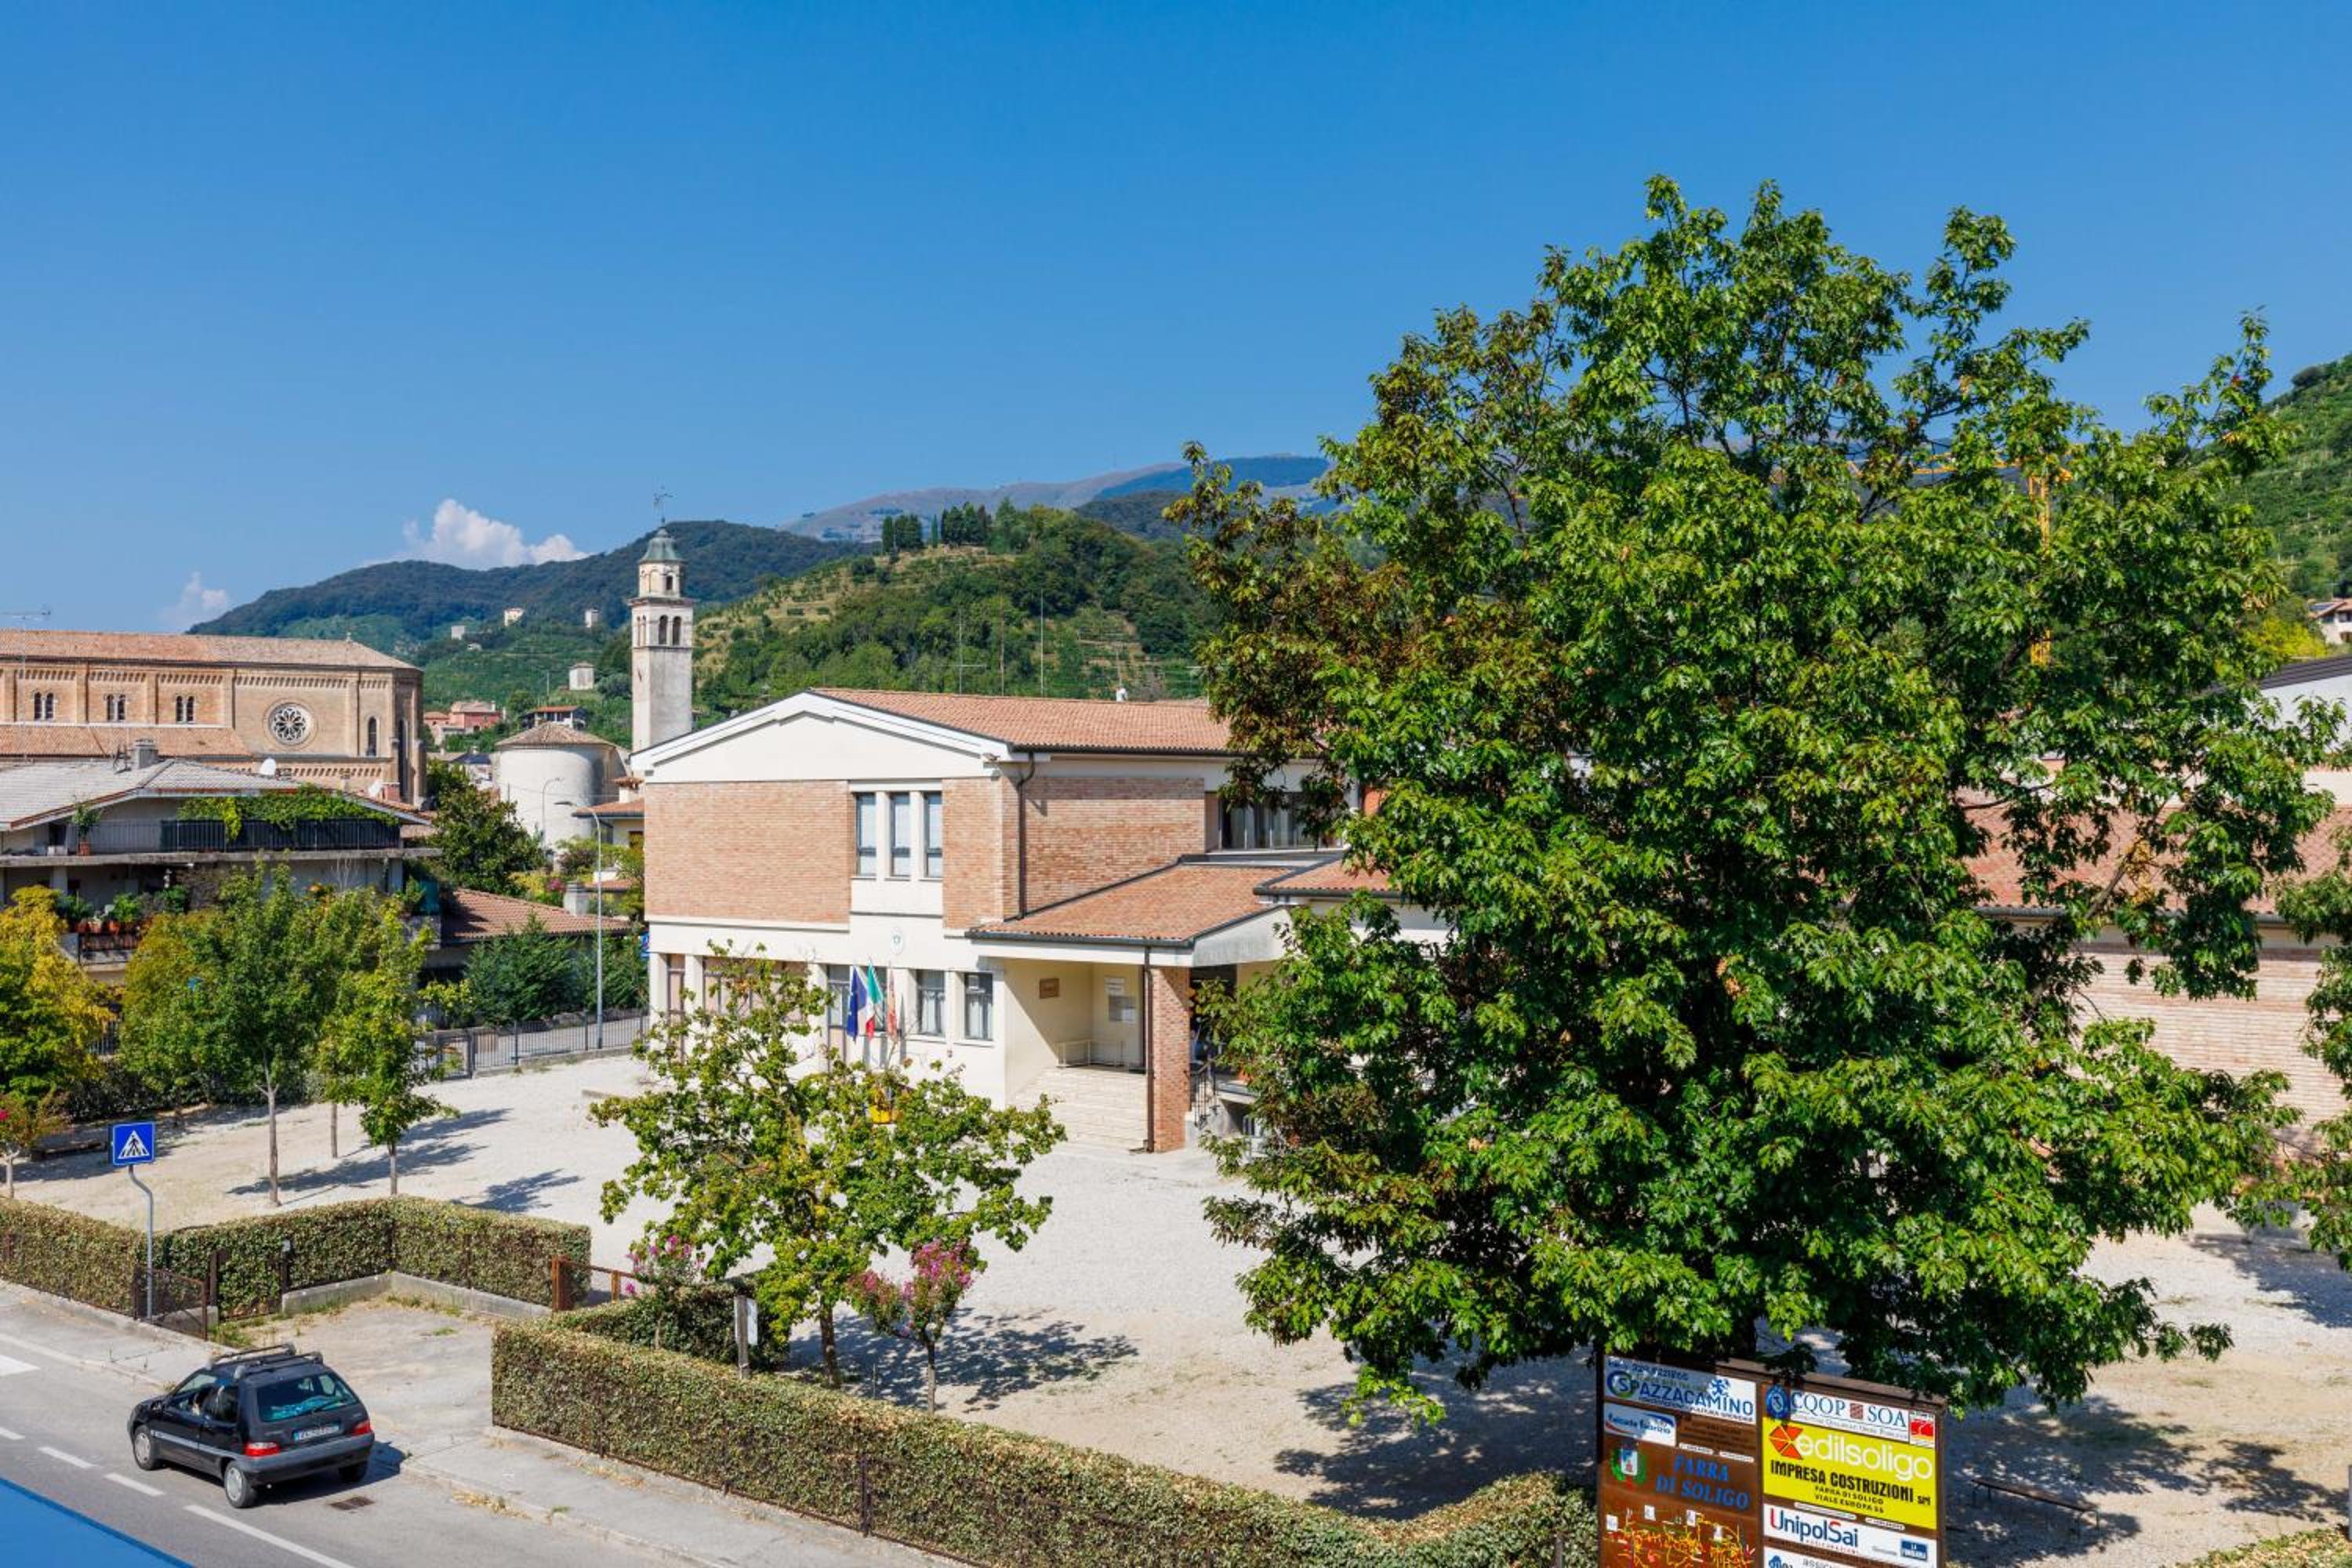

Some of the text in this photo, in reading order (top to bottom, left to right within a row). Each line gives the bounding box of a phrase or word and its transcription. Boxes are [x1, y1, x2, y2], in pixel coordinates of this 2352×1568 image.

[1791, 1391, 1846, 1417] CQOP
[1867, 1406, 1907, 1428] SOA
[1673, 1454, 1730, 1481] FARRA
[1795, 1433, 1933, 1481] edilsoligo
[1655, 1474, 1751, 1509] DI SOLIGO
[1771, 1460, 1826, 1484] IMPRESA
[1830, 1472, 1914, 1503] COSTRUZIONI
[1853, 1494, 1884, 1505] SOLIGO
[1769, 1508, 1859, 1548] UnipolSai
